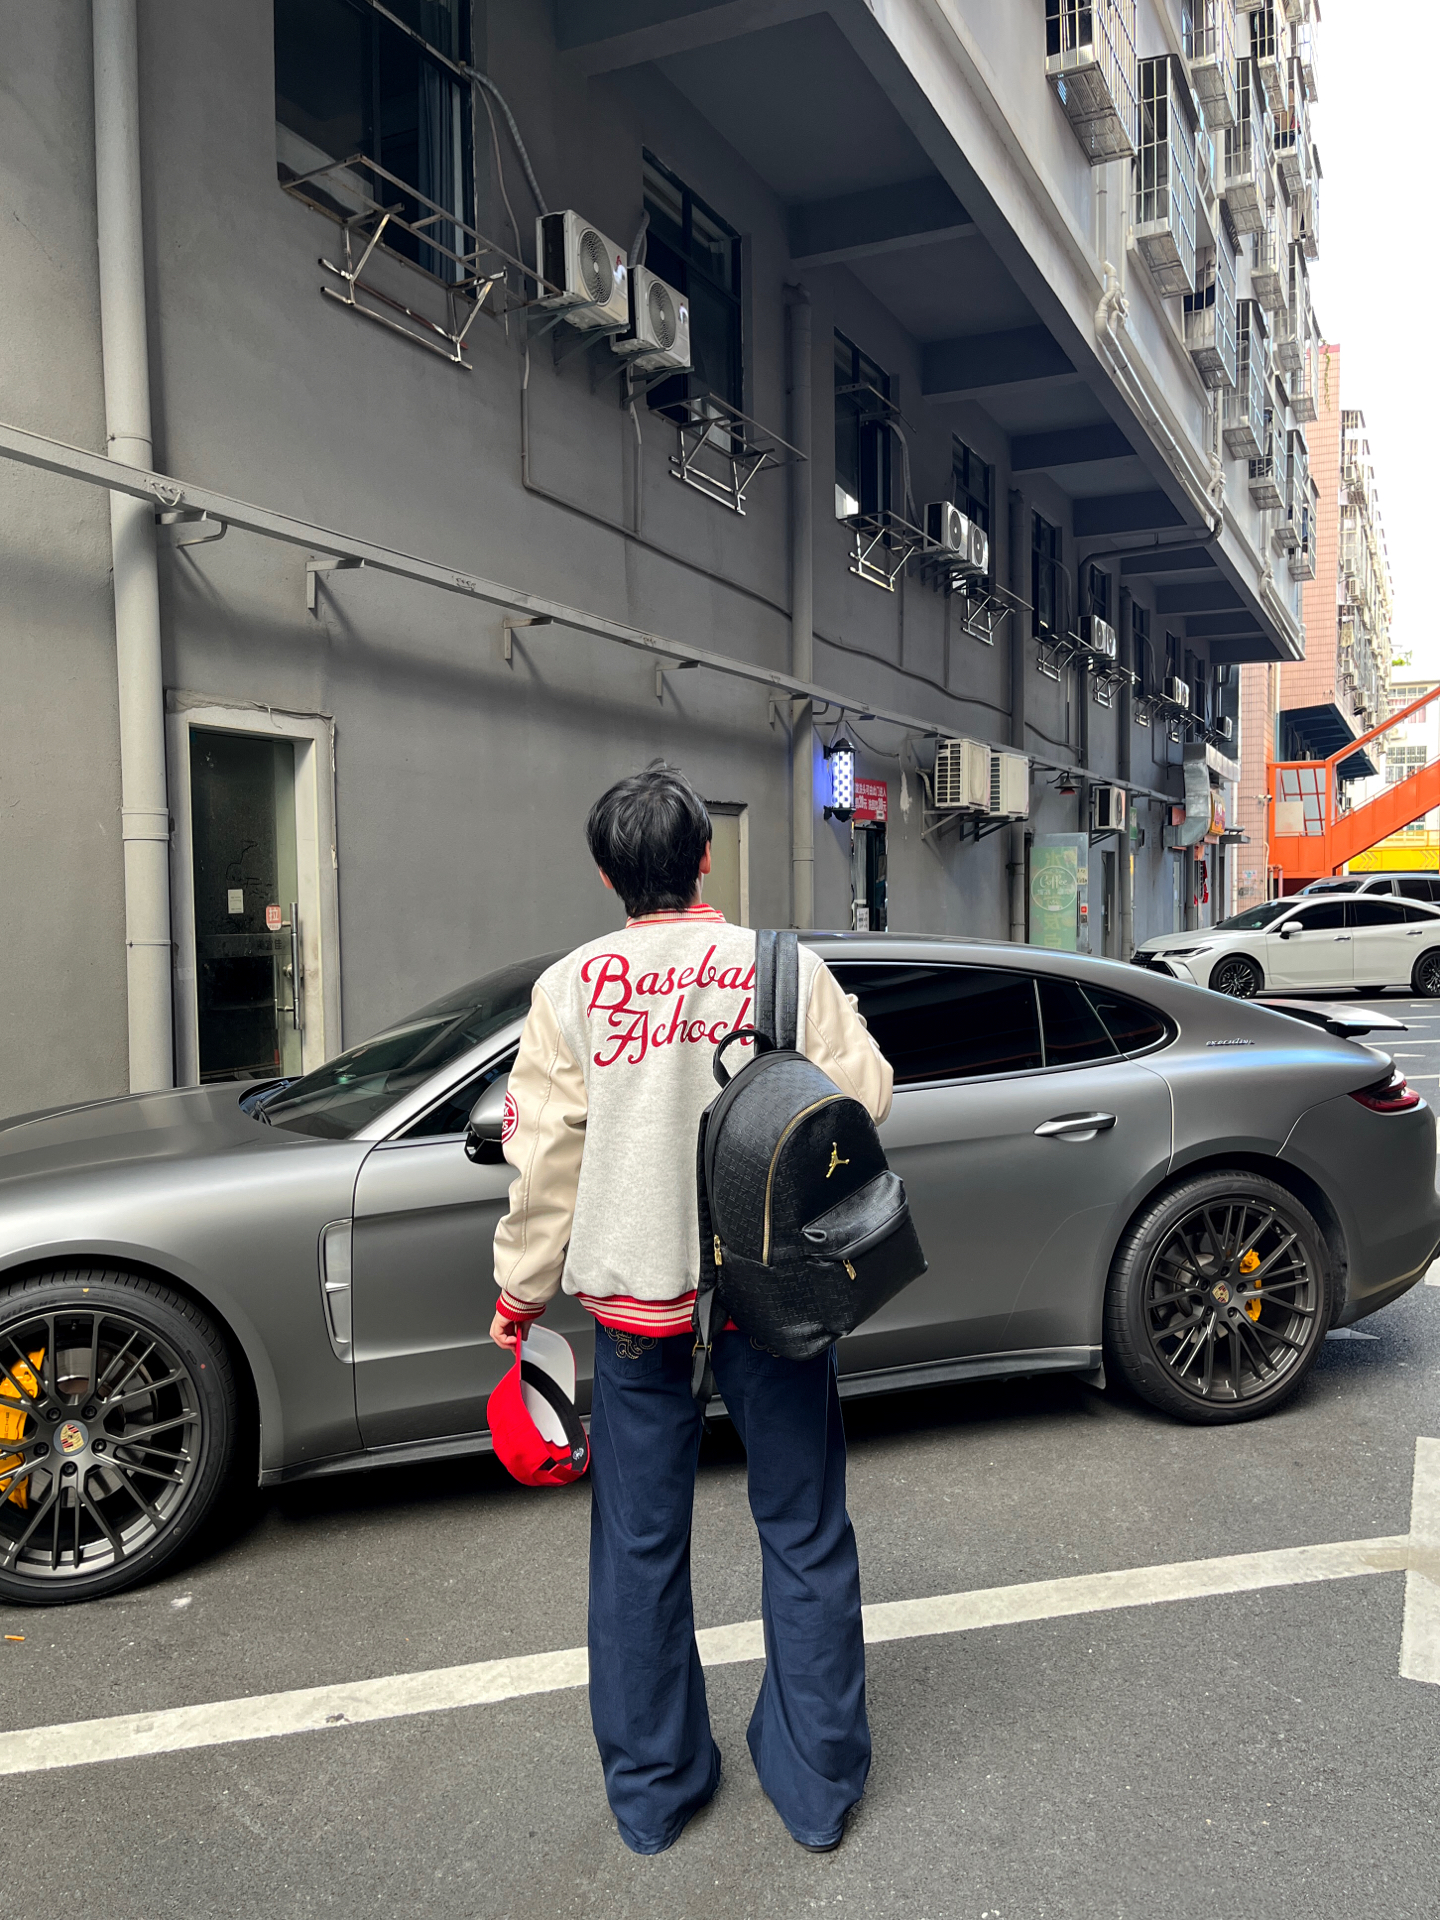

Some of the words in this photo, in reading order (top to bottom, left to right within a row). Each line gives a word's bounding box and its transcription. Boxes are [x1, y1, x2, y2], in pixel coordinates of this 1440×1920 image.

[1039, 874, 1068, 889] Coffee
[268, 907, 279, 922] 拉
[581, 944, 756, 1019] Basebal
